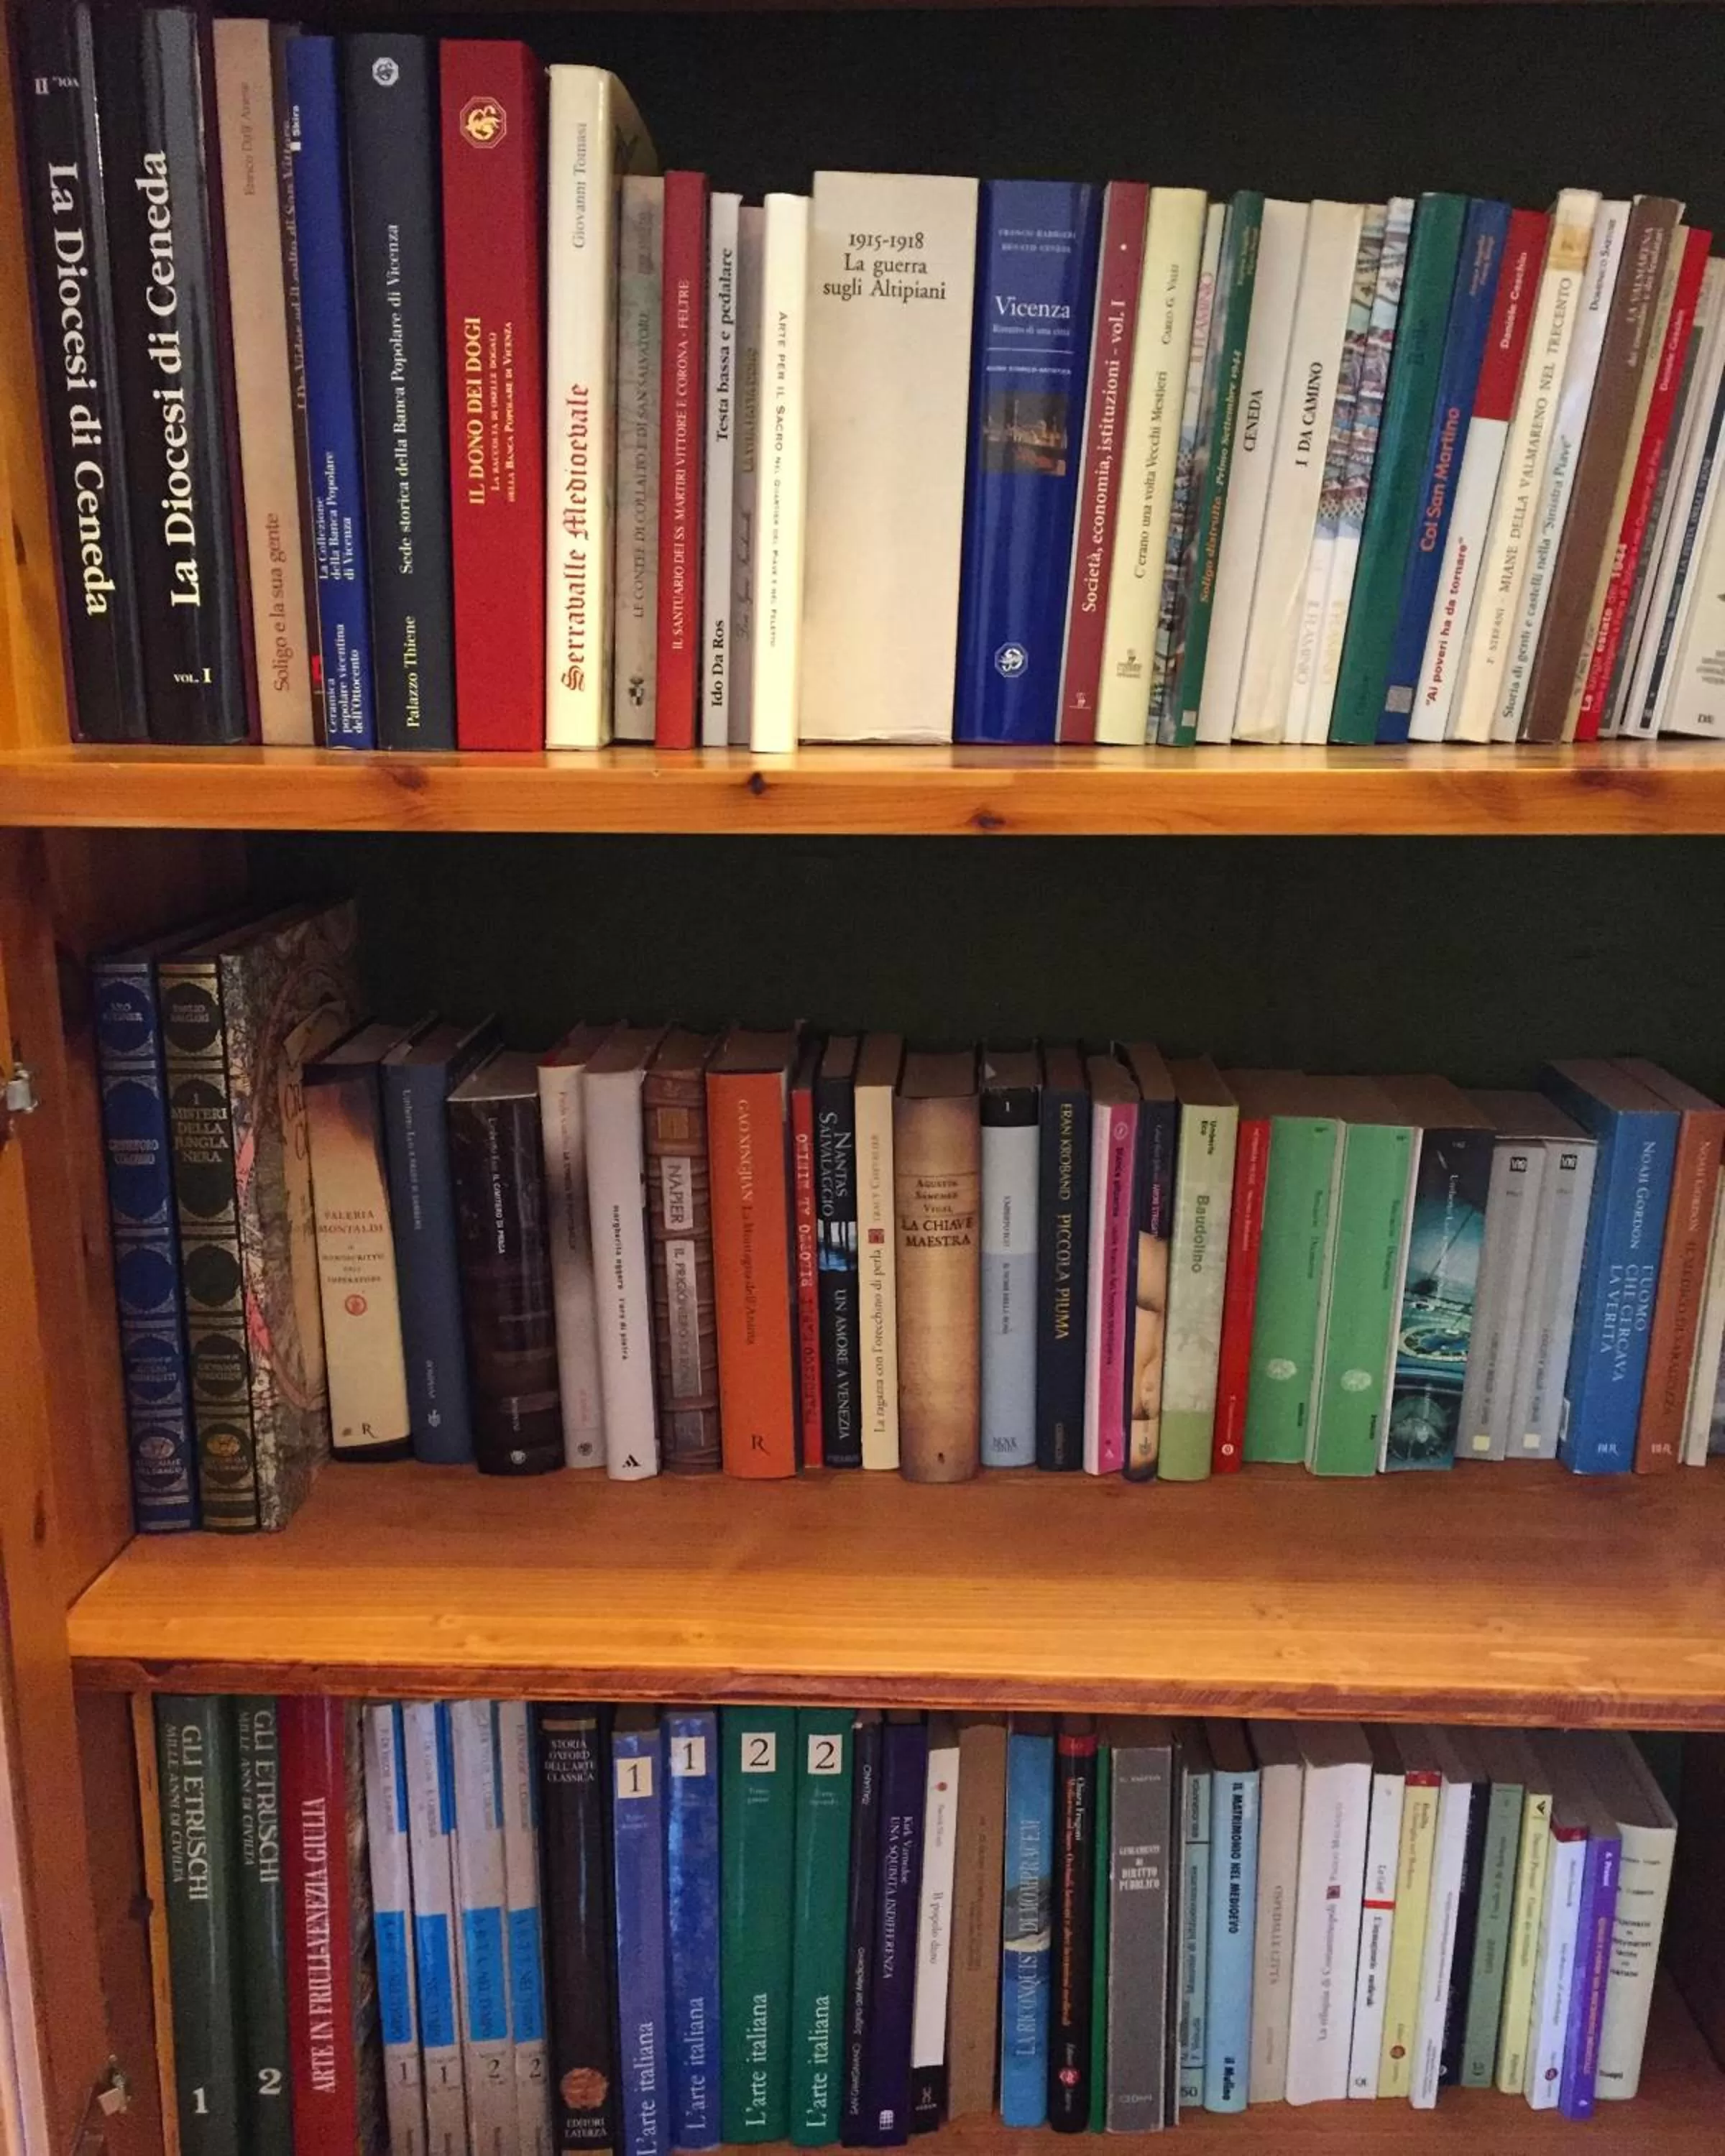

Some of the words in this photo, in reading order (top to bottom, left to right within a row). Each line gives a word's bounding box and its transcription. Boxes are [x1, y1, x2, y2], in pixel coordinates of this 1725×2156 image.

[573, 122, 588, 176] Tomasi
[49, 162, 79, 214] La
[135, 150, 177, 317] Ceneda
[572, 180, 587, 249] Giovanni
[385, 224, 400, 286] Vicenza
[847, 231, 924, 252] 1915-1918
[717, 247, 735, 326] pedalare
[843, 253, 865, 272] La
[872, 259, 929, 278] guerra
[1508, 252, 1528, 300] Ceschin
[55, 227, 98, 390] Diocesi
[387, 292, 401, 308] di
[677, 280, 689, 329] FELTRE
[822, 278, 862, 301] sugli
[869, 278, 946, 305] Altipiani
[995, 295, 1070, 319] Vicenza
[389, 313, 407, 382] Popolare
[464, 317, 482, 372] DOGI
[720, 331, 730, 341] e
[1108, 311, 1126, 344] vol.
[1499, 303, 1519, 350] Daniele
[147, 333, 180, 375] di
[676, 341, 689, 396] CORONA
[715, 346, 731, 393] bassa
[392, 386, 407, 433] Banca
[465, 379, 484, 414] DEI
[1098, 359, 1121, 451] istituzioni
[1151, 371, 1168, 423] Mestieri
[1301, 361, 1324, 426] CAMINO
[69, 405, 104, 447] di
[675, 410, 687, 466] VITTORE
[715, 398, 730, 443] Testa
[1242, 390, 1264, 453] CENEDA
[1296, 430, 1313, 453] DA
[394, 438, 409, 477] della
[466, 419, 484, 479] DONO
[562, 383, 589, 541] Medioevale
[1144, 426, 1161, 468] Vecchi
[1433, 407, 1460, 482] Martino
[152, 389, 196, 547] Diocesi
[324, 451, 339, 505] Popolare
[1143, 470, 1156, 502] volta
[397, 481, 411, 533] storica
[468, 483, 486, 505] IL
[674, 469, 686, 520] MARTIRI
[1090, 454, 1113, 544] economia,
[1141, 505, 1153, 528] una
[1426, 482, 1447, 518] San
[73, 460, 115, 617] Ceneda
[266, 512, 286, 563] gente
[327, 509, 339, 546] Banca
[342, 517, 354, 565] Vicenza
[1419, 522, 1438, 553] Col
[328, 549, 341, 580] della
[344, 568, 355, 580] di
[399, 535, 413, 575] Sede
[673, 542, 685, 563] DEI
[171, 558, 202, 607] La
[270, 566, 285, 599] sua
[672, 566, 685, 636] SANTUARIO
[1081, 547, 1104, 613] Società,
[270, 602, 285, 618] la
[275, 621, 286, 633] e
[561, 548, 587, 692] Serravalle
[334, 624, 346, 679] vicentina
[403, 616, 418, 669] Thiene
[672, 637, 684, 650] IL
[712, 619, 725, 650] Ros
[273, 636, 293, 692] Soligo
[712, 653, 724, 677] Da
[326, 678, 337, 734] Ceramica
[337, 681, 351, 734] popolare
[349, 649, 364, 734] dell'Ottocento
[405, 673, 420, 728] Palazzo
[711, 680, 724, 707] Ido
[170, 1107, 228, 1120] MISTERI
[177, 1121, 225, 1135] DELLA
[737, 1099, 751, 1133] GAO
[182, 1150, 223, 1163] NERA
[739, 1133, 753, 1201] XINGJIAN
[819, 1111, 838, 1217] SALVALAGGIO
[834, 1131, 852, 1197] NANTAS
[1638, 1141, 1657, 1184] NOAH
[323, 1210, 375, 1220] VALERIA
[668, 1164, 685, 1224] NAPIER
[318, 1223, 384, 1235] MONTALDI
[901, 1217, 919, 1231] LA
[922, 1216, 973, 1231] CHIAVE
[1191, 1194, 1210, 1273] Baudolino
[1629, 1186, 1650, 1249] GORDON
[674, 1248, 686, 1258] IL
[868, 1250, 885, 1277] perla
[905, 1234, 971, 1248] MAESTRA
[1056, 1213, 1072, 1283] PICCOLA
[834, 1288, 847, 1311] UN
[869, 1279, 882, 1291] di
[1624, 1263, 1638, 1300] CHE
[1634, 1264, 1655, 1331] L'UOMO
[870, 1294, 883, 1353] l'orecchino
[1054, 1286, 1072, 1340] PIUMA
[835, 1314, 848, 1365] AMORE
[1611, 1304, 1632, 1382] CERCAVA
[837, 1370, 848, 1378] A
[874, 1355, 884, 1377] con
[837, 1381, 850, 1439] VENEZIA
[875, 1378, 887, 1416] ragazza
[361, 1422, 377, 1439] R
[750, 1435, 768, 1454] R
[873, 1419, 886, 1432] La
[165, 1723, 180, 1769] MILLE
[181, 1724, 203, 1766] GLI
[253, 1710, 277, 1751] GLI
[749, 1737, 770, 1767] 2
[625, 1763, 642, 1793] 1
[682, 1741, 695, 1770] 1
[815, 1740, 835, 1770] 2
[168, 1772, 181, 1808] ANNI
[1233, 1782, 1243, 1791] IL
[170, 1812, 182, 1826] DI
[183, 1775, 208, 1901] ETRUSCHI
[254, 1759, 280, 1883] ETRUSCHI
[300, 1797, 327, 1863] GIULIA
[1230, 1793, 1243, 1859] MATRIMONIO
[1018, 1820, 1041, 1915] MOMPRACEM
[1230, 1861, 1241, 1881] NEL
[1019, 1917, 1038, 1932] DI
[1228, 1882, 1241, 1935] MEDIOEVO
[305, 1869, 333, 2015] FRIULI-VENEZIA
[1016, 1945, 1040, 2032] RICONQUIST
[310, 2017, 334, 2040] IN
[683, 1996, 706, 2066] italiana
[745, 1993, 768, 2063] italiana
[806, 1994, 830, 2065] italiana
[1016, 2035, 1036, 2056] LA
[310, 2045, 336, 2093] ARTE
[400, 2062, 408, 2081] 1
[440, 2065, 447, 2084] 1
[487, 2058, 501, 2079] 2
[529, 2058, 541, 2078] 2
[632, 2021, 656, 2092] italiana
[192, 2087, 209, 2114] 1
[258, 2067, 282, 2096] 2
[685, 2074, 707, 2129] L'arte
[745, 2071, 768, 2127] L'arte
[805, 2072, 828, 2128] L'arte
[1180, 2086, 1198, 2098] 50
[1222, 2065, 1235, 2101] Mulino
[635, 2099, 657, 2156] L'arte
